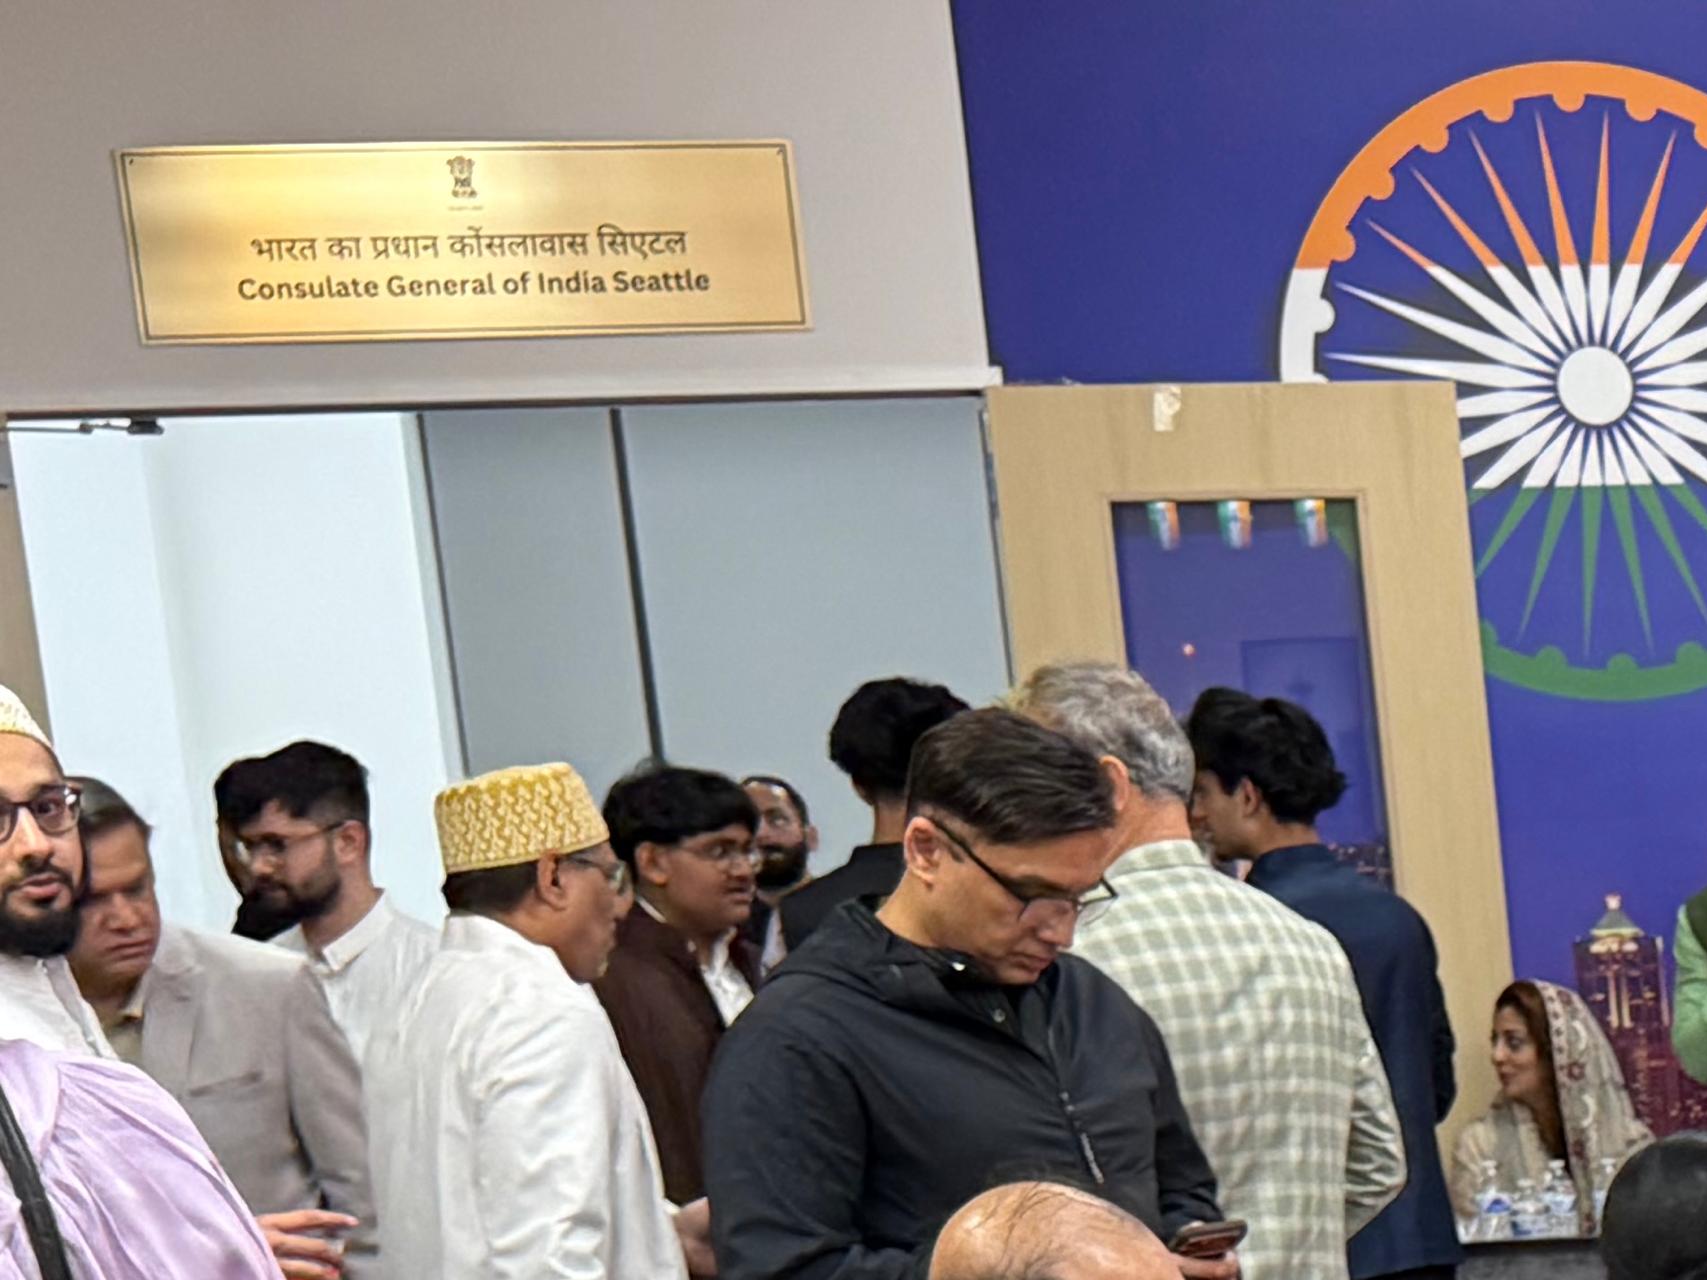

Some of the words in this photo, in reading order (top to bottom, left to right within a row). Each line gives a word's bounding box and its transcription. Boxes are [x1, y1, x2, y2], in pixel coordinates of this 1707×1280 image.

[250, 237, 317, 262] भारत
[325, 236, 362, 260] का
[369, 235, 439, 260] प्रधान
[596, 222, 688, 260] सिएटल
[237, 275, 380, 301] Consulate
[386, 272, 494, 298] General
[502, 271, 531, 295] of
[538, 270, 608, 295] India
[613, 268, 711, 293] Seattle
